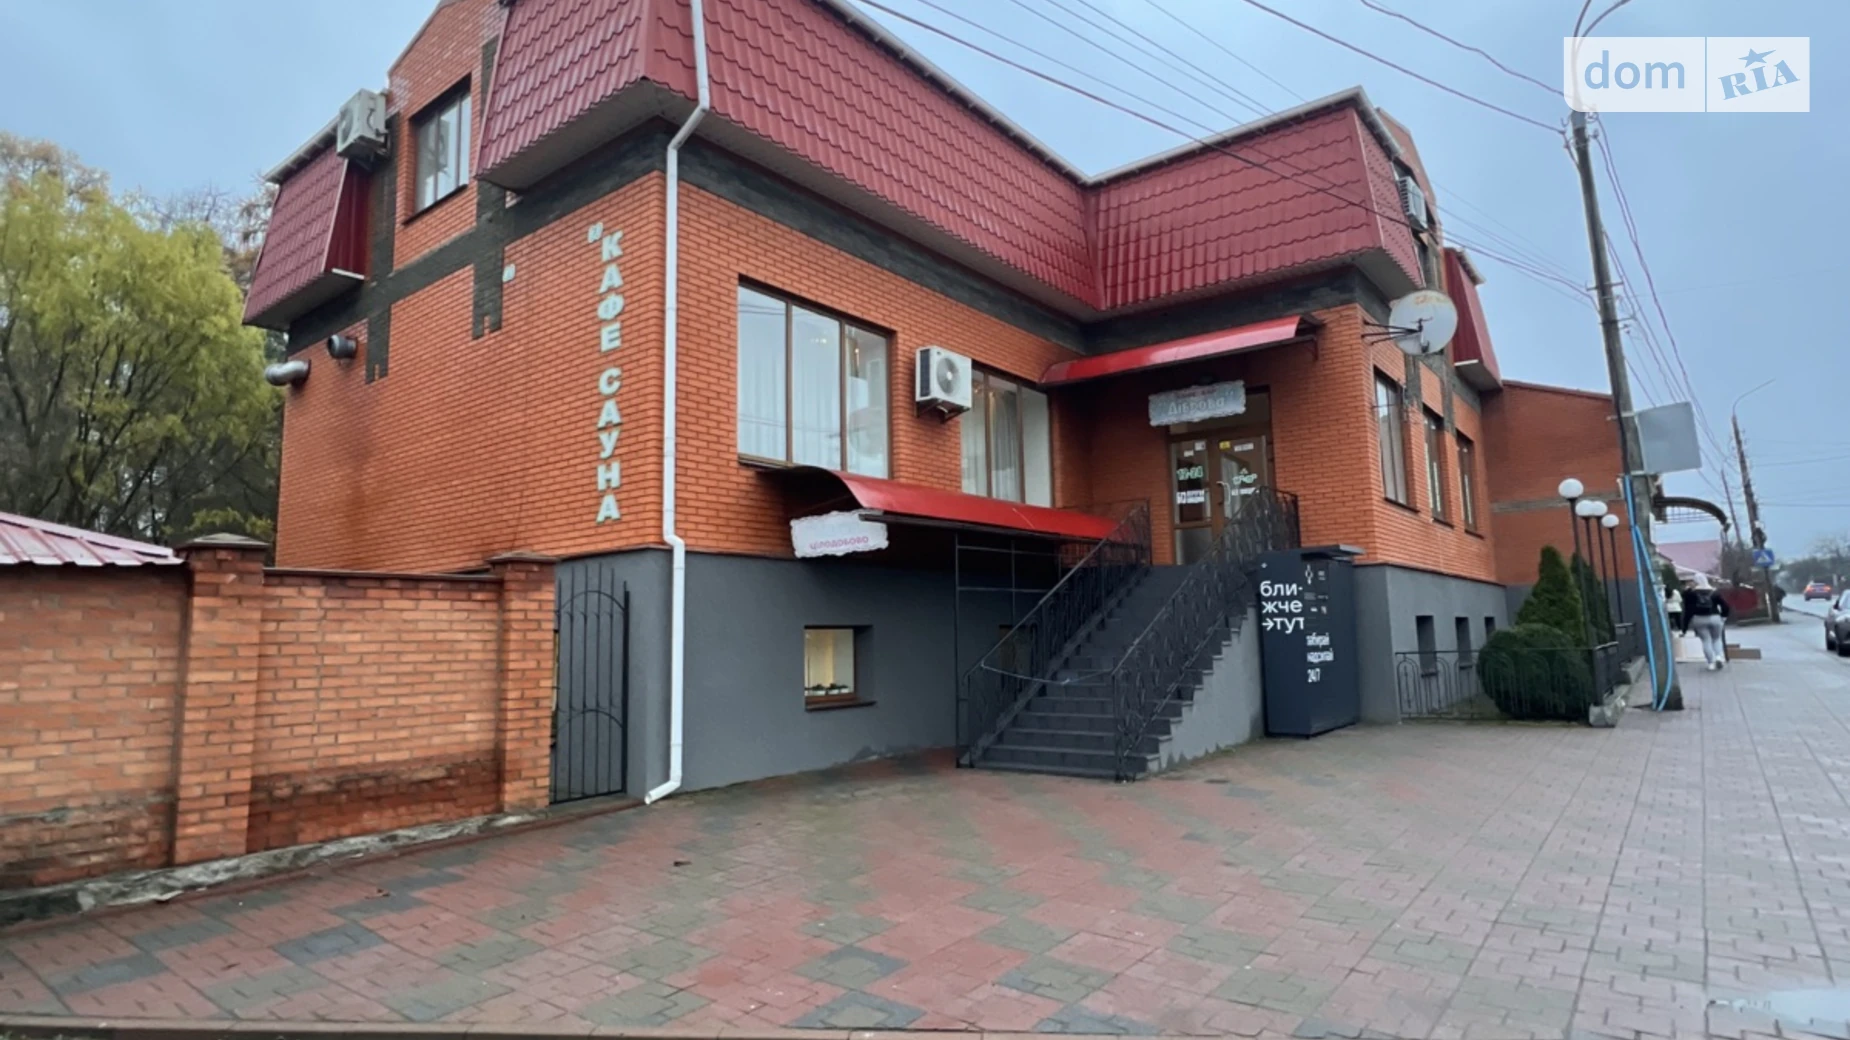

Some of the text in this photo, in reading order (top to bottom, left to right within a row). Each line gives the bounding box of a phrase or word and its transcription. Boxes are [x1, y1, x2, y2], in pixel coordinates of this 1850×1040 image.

[596, 367, 623, 523] САУНА
[1261, 600, 1303, 613] жче
[1273, 617, 1305, 634] тут
